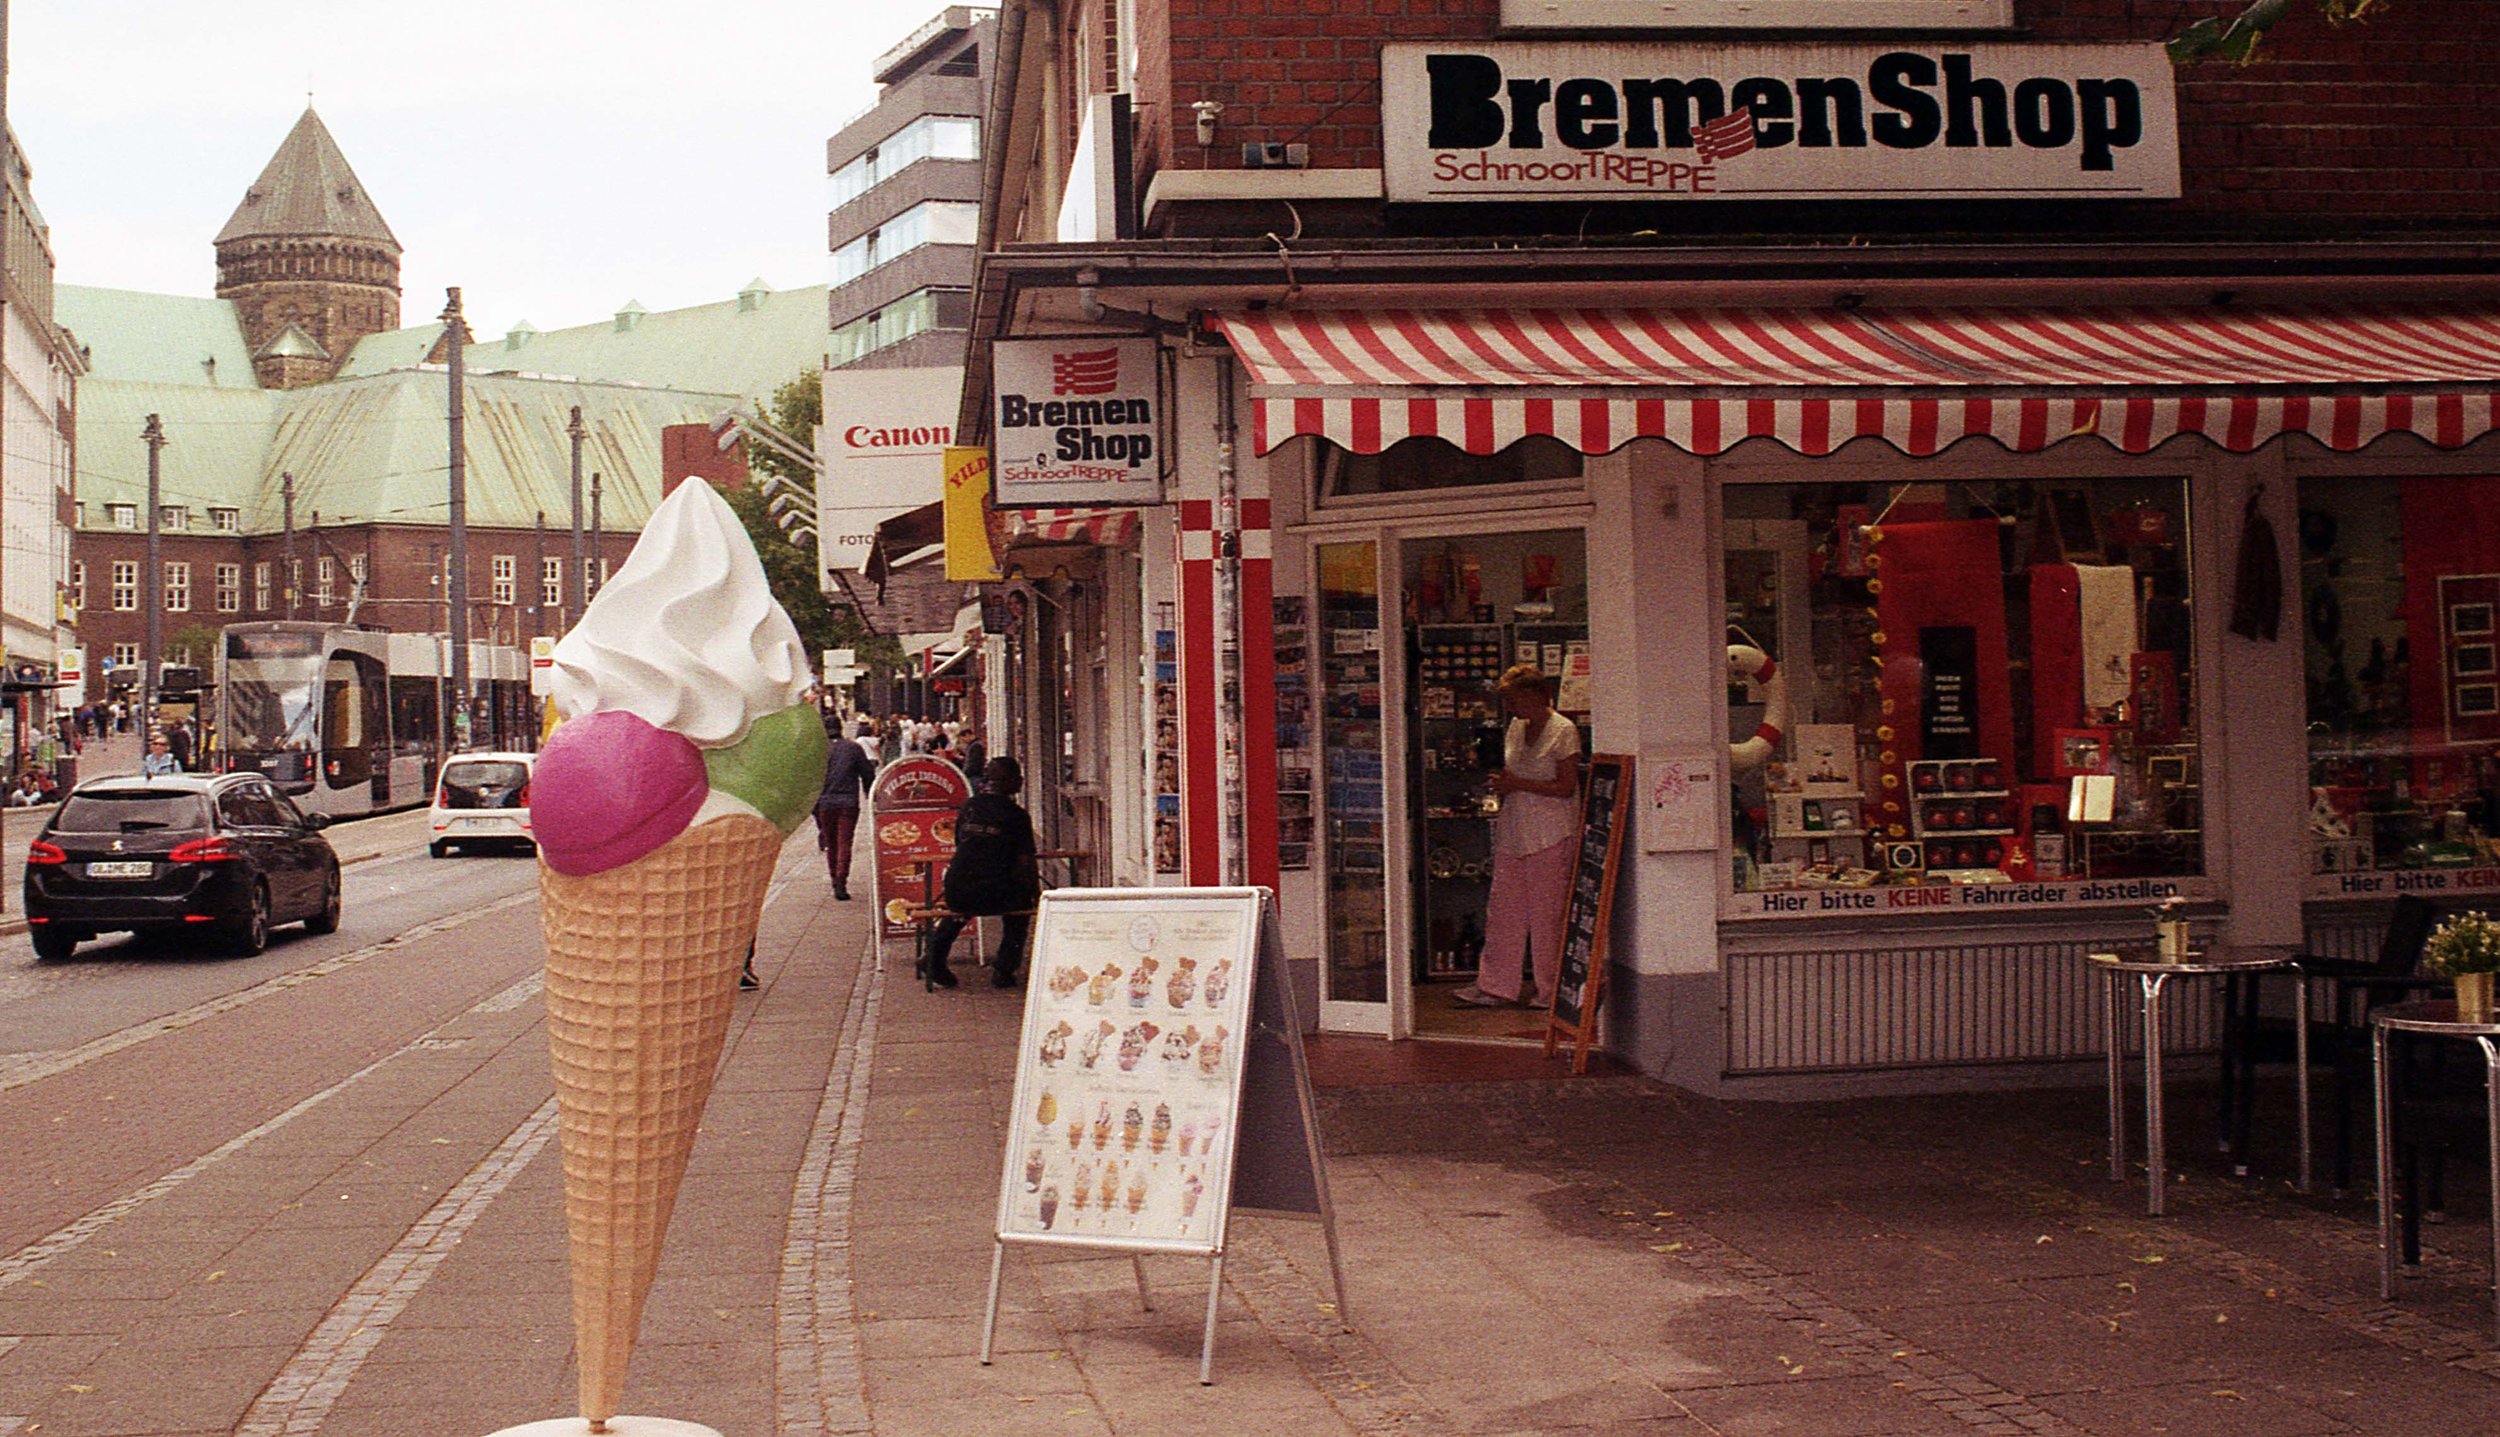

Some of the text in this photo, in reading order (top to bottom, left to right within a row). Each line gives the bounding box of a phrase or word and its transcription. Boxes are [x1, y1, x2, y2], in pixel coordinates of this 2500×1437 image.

[1426, 51, 2143, 170] BremenShop
[1433, 150, 1717, 193] SchnoorTREPPE
[1001, 394, 1151, 428] Bremen
[844, 425, 951, 449] Canon
[1055, 427, 1152, 468] Shop
[1003, 464, 1129, 483] SchnoorTREPPE
[1762, 880, 2178, 911] Hier bitte KEINE Fahrräder abstellen
[2341, 872, 2384, 892] Hier
[2394, 871, 2446, 890] bitte
